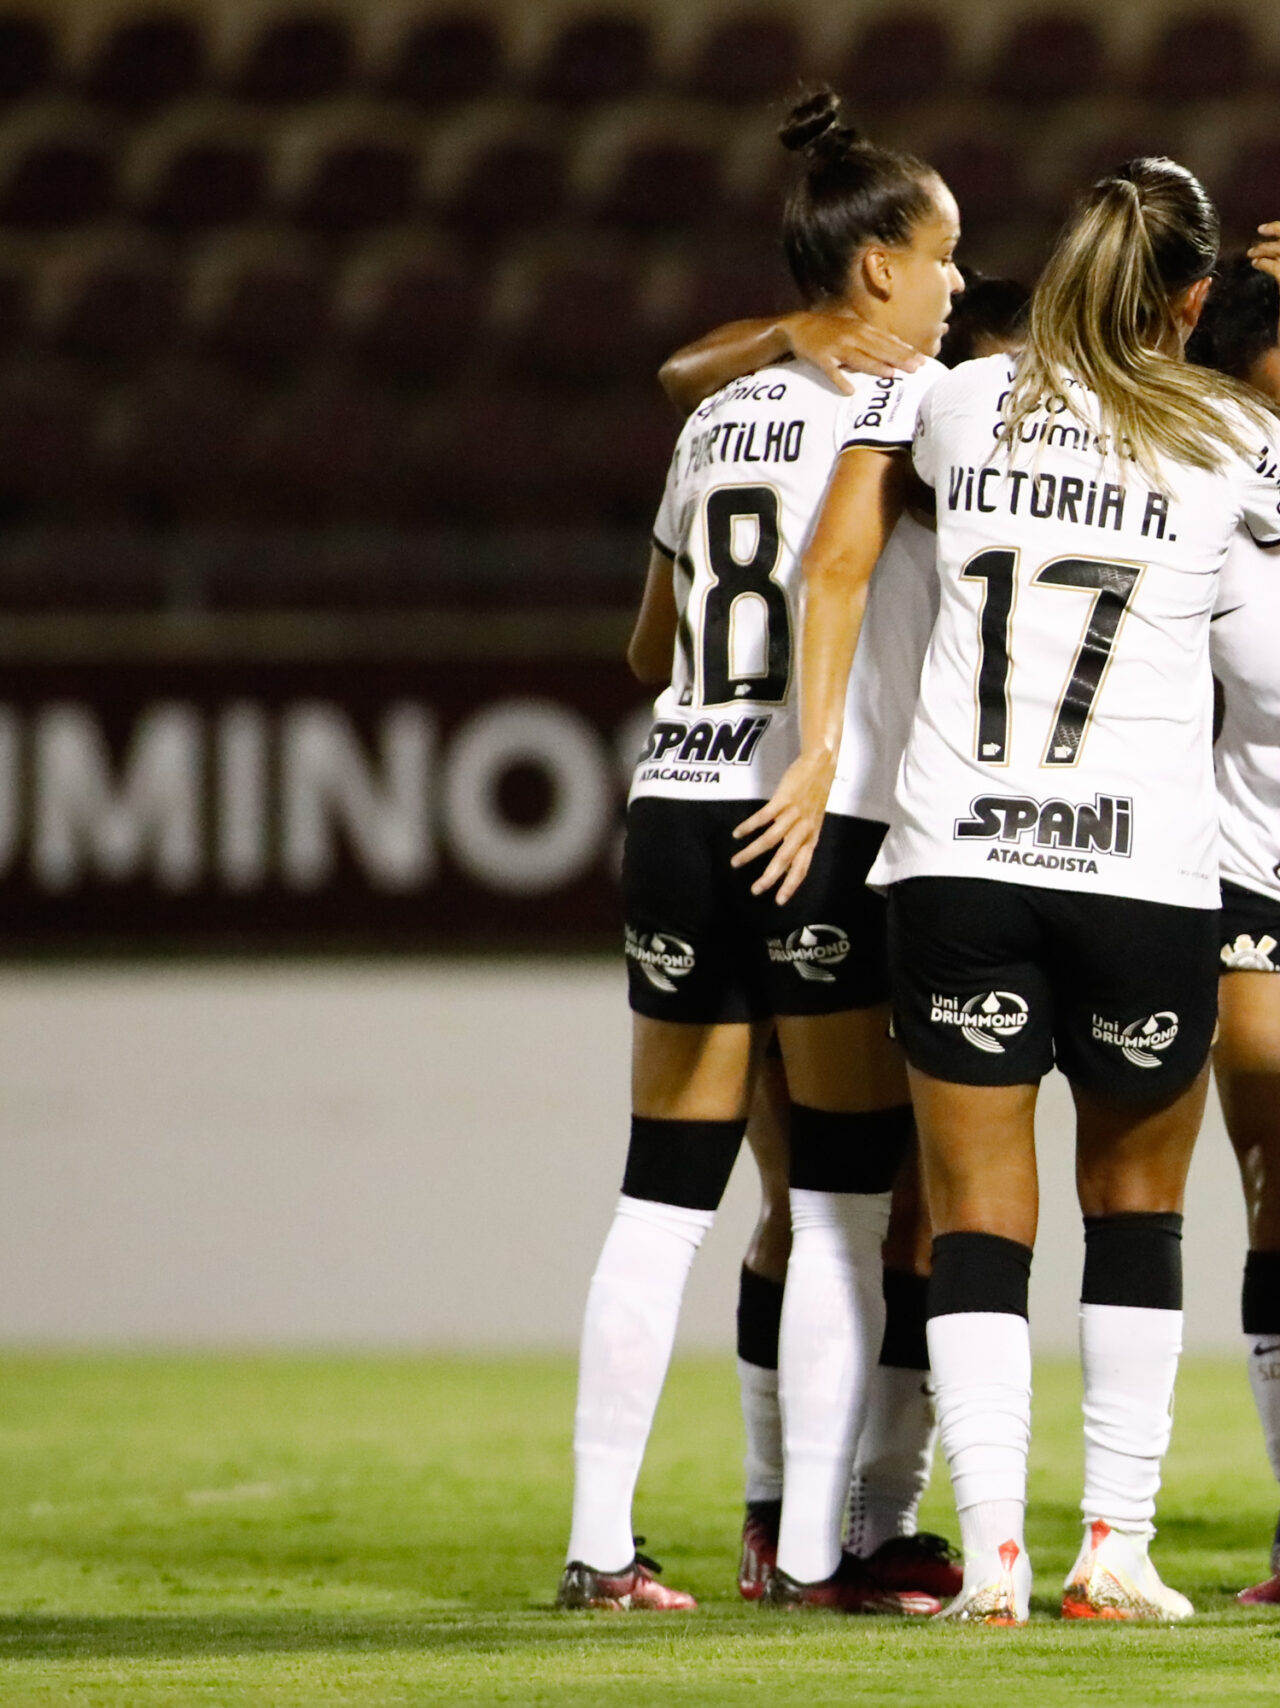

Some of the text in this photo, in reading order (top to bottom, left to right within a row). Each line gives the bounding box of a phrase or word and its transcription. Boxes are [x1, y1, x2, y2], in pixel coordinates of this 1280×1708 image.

[996, 390, 1067, 415] no
[677, 482, 793, 711] 8
[961, 545, 1148, 768] 17
[640, 768, 720, 783] ATACADISTA
[0, 697, 652, 896] MINO
[986, 848, 1099, 874] ATACADISTA
[931, 993, 959, 1010] Uni
[930, 1007, 1028, 1028] DRUMMOND
[1093, 1013, 1119, 1033] Uni
[1092, 1024, 1179, 1048] DRUMMOND
